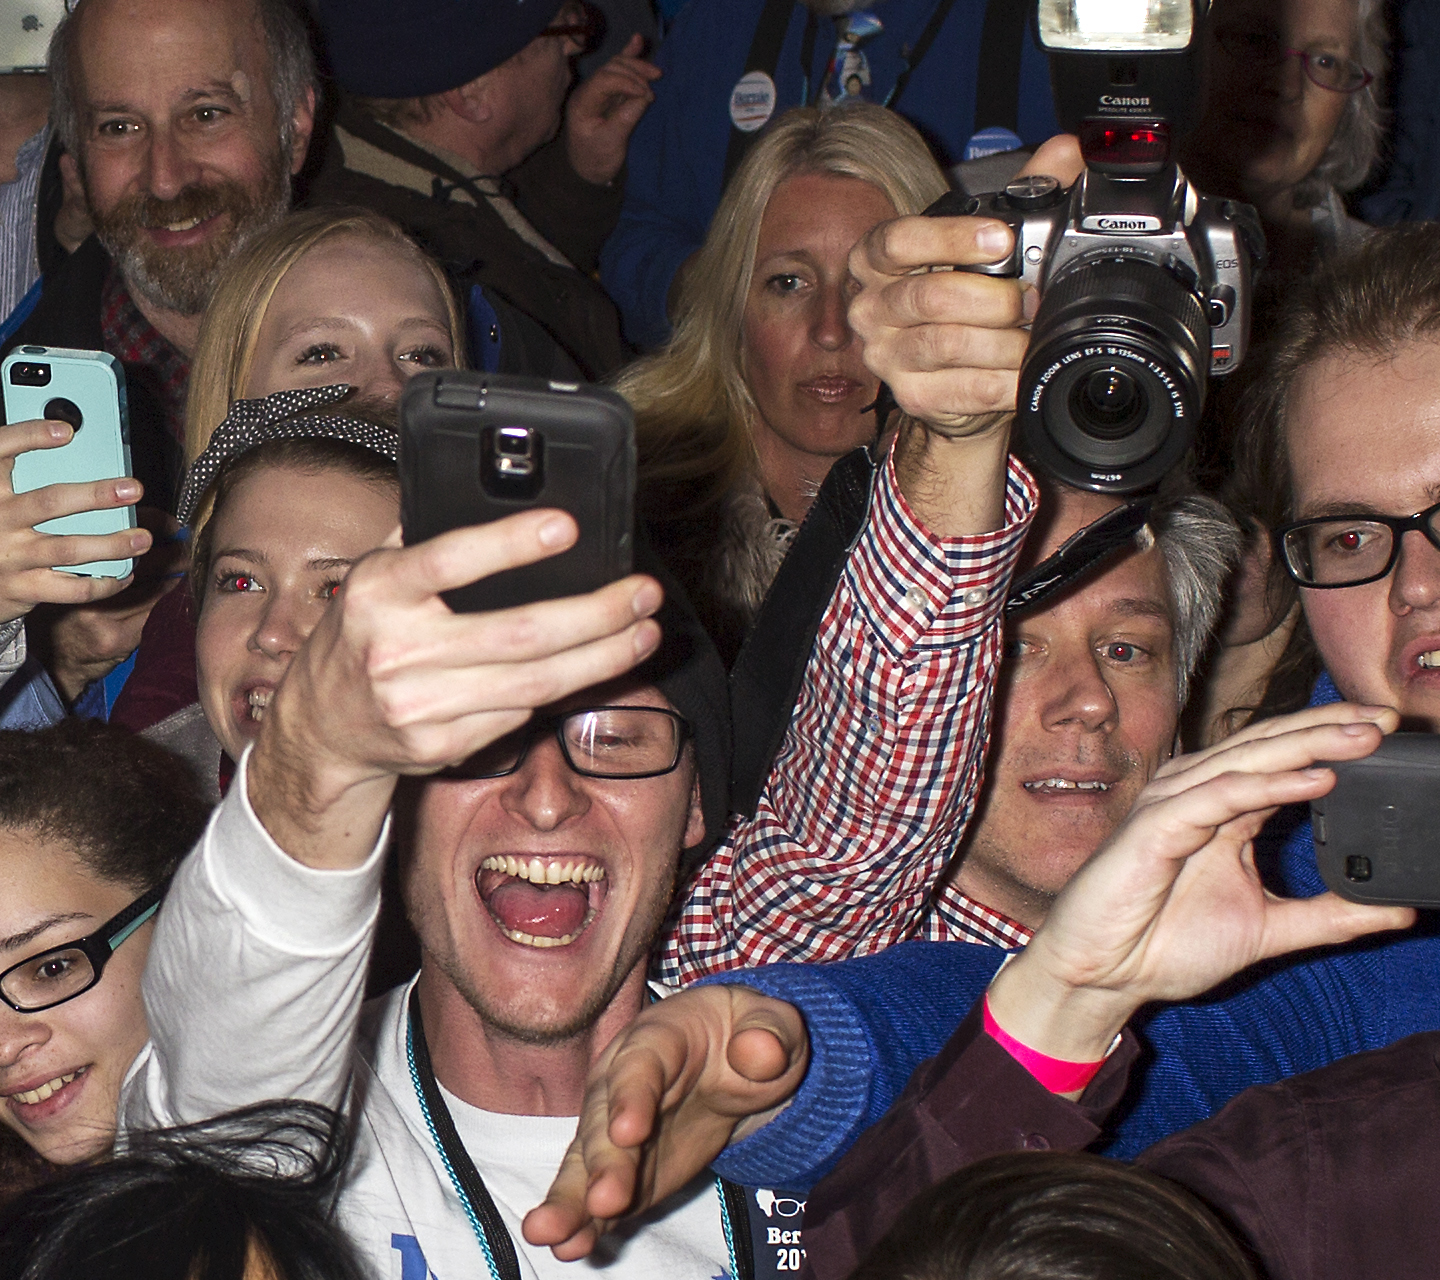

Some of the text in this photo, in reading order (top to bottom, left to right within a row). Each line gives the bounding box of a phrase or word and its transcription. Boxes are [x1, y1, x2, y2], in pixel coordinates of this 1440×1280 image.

[1099, 95, 1150, 106] Canon
[1097, 218, 1146, 230] Canon
[1216, 259, 1238, 269] EOS
[1062, 351, 1082, 365] LENS
[1084, 347, 1103, 356] EF-S
[1107, 347, 1146, 363] 18-135mm
[1040, 362, 1062, 383] ZOOM
[1030, 384, 1044, 412] CANON
[1171, 391, 1180, 399] IS
[1173, 401, 1184, 418] STM
